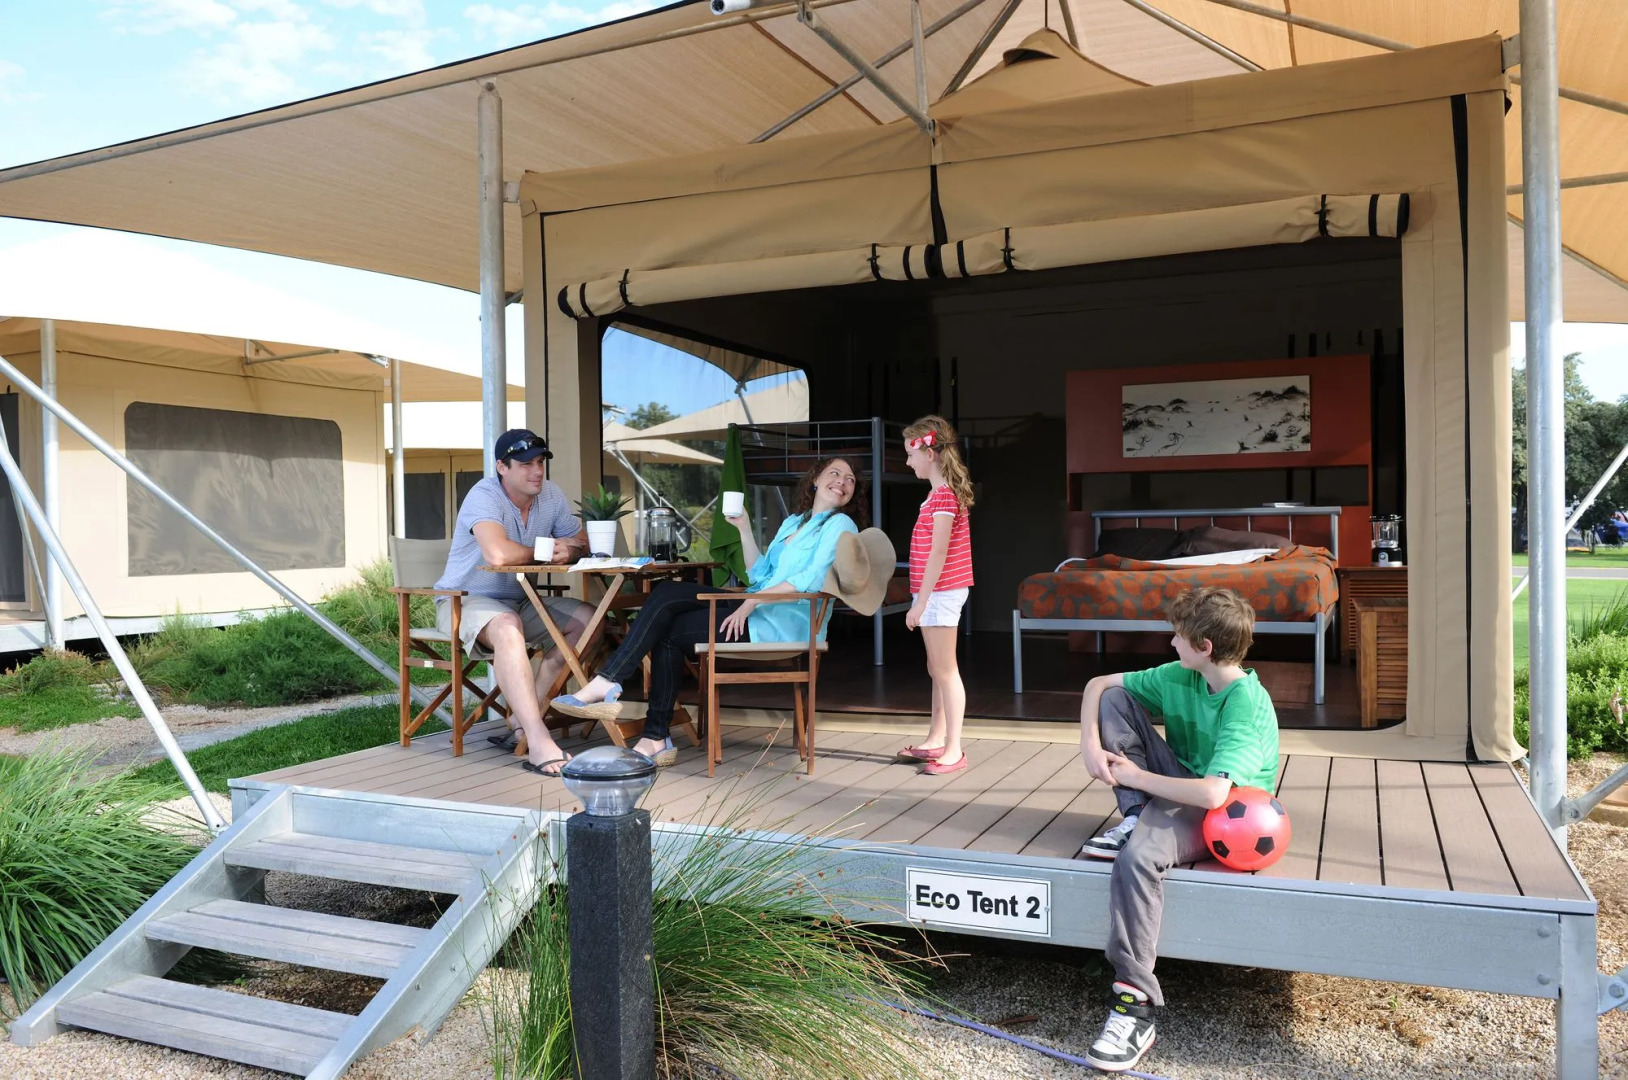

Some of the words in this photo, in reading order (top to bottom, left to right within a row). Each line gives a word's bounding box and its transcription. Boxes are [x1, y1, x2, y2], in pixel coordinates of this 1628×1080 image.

[916, 884, 960, 911] Eco
[967, 890, 1019, 917] Tent
[1026, 896, 1040, 919] 2
